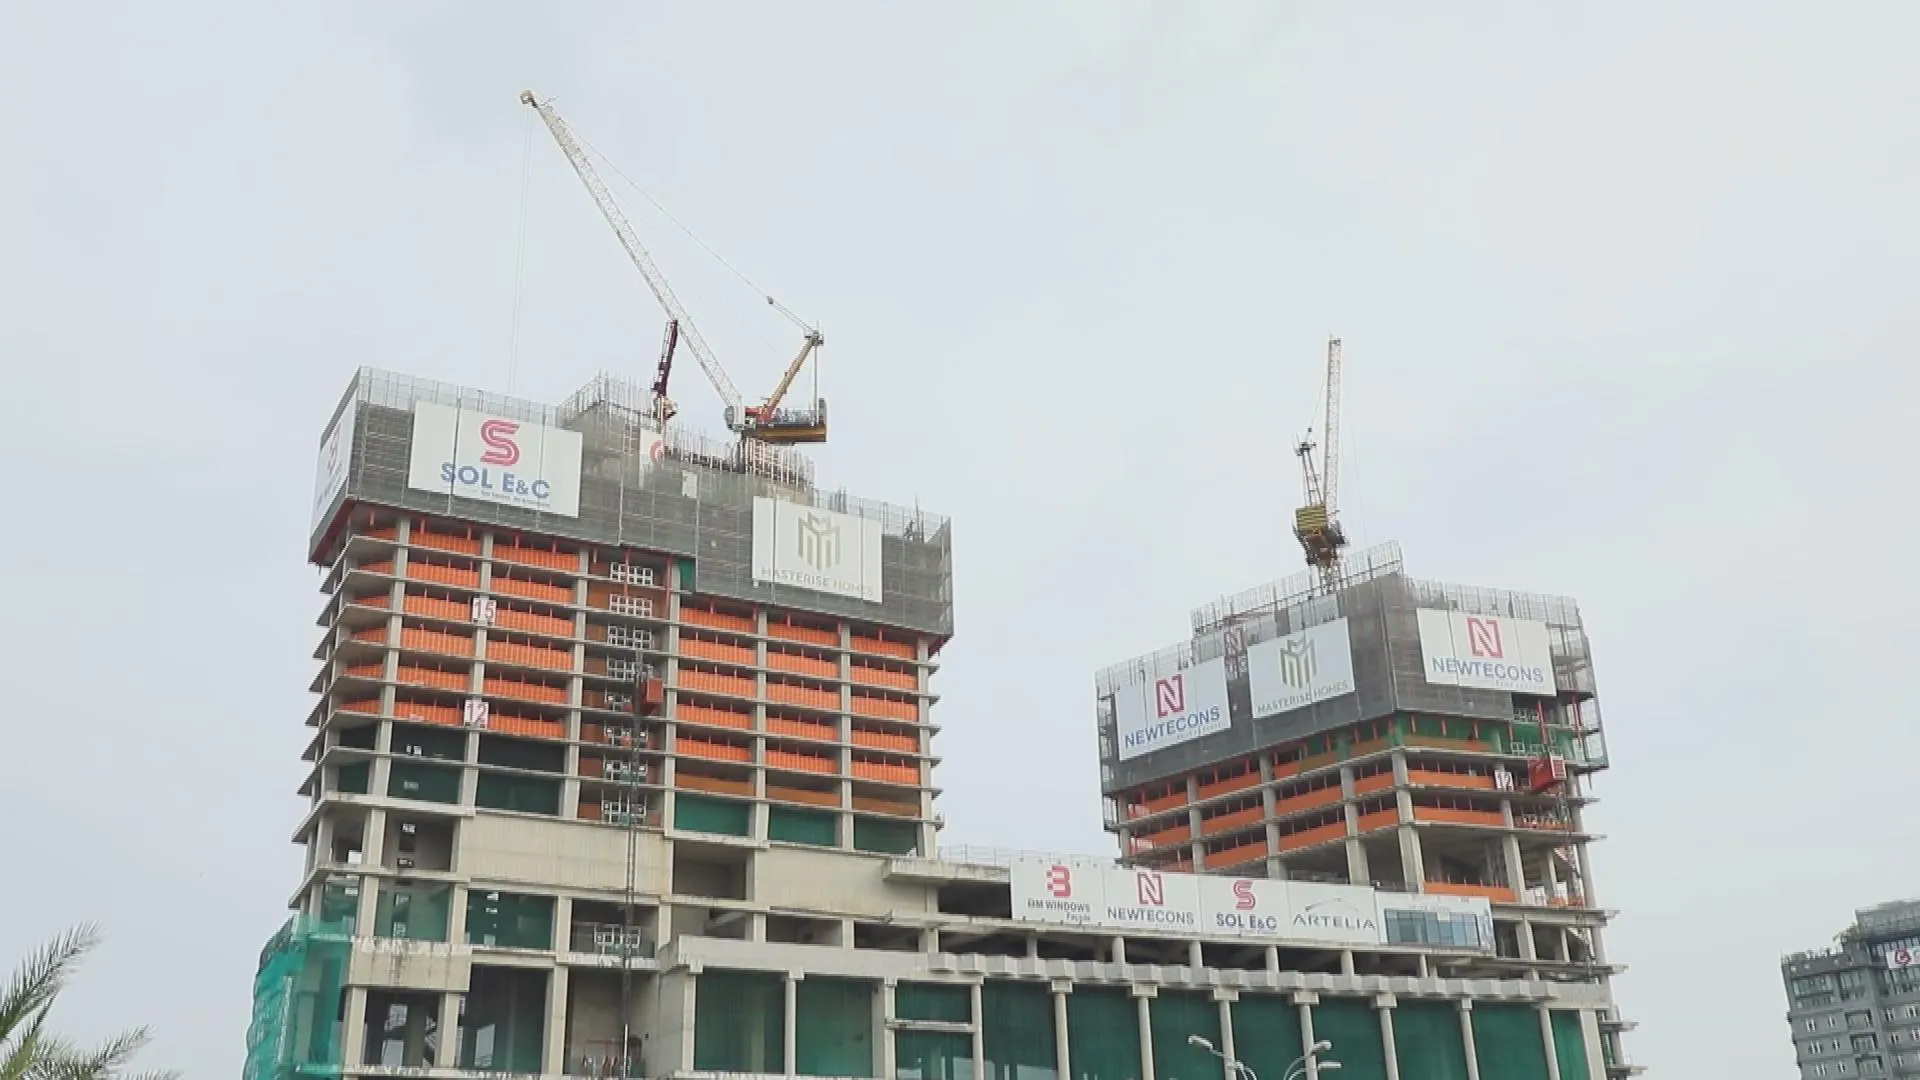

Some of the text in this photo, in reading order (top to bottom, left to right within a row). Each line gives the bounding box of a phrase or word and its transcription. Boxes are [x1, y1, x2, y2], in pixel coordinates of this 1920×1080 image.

[440, 462, 493, 489] SOL
[502, 472, 550, 498] E&C
[473, 600, 495, 623] 15
[1432, 657, 1544, 682] NEWTECONS
[465, 702, 488, 727] 12
[1125, 705, 1220, 748] NEWTECONS
[1045, 901, 1090, 913] WINDOWS
[1107, 907, 1195, 925] NEWTECONS
[1216, 913, 1277, 930] SOL E&C
[1293, 913, 1376, 930] ARTELIA
